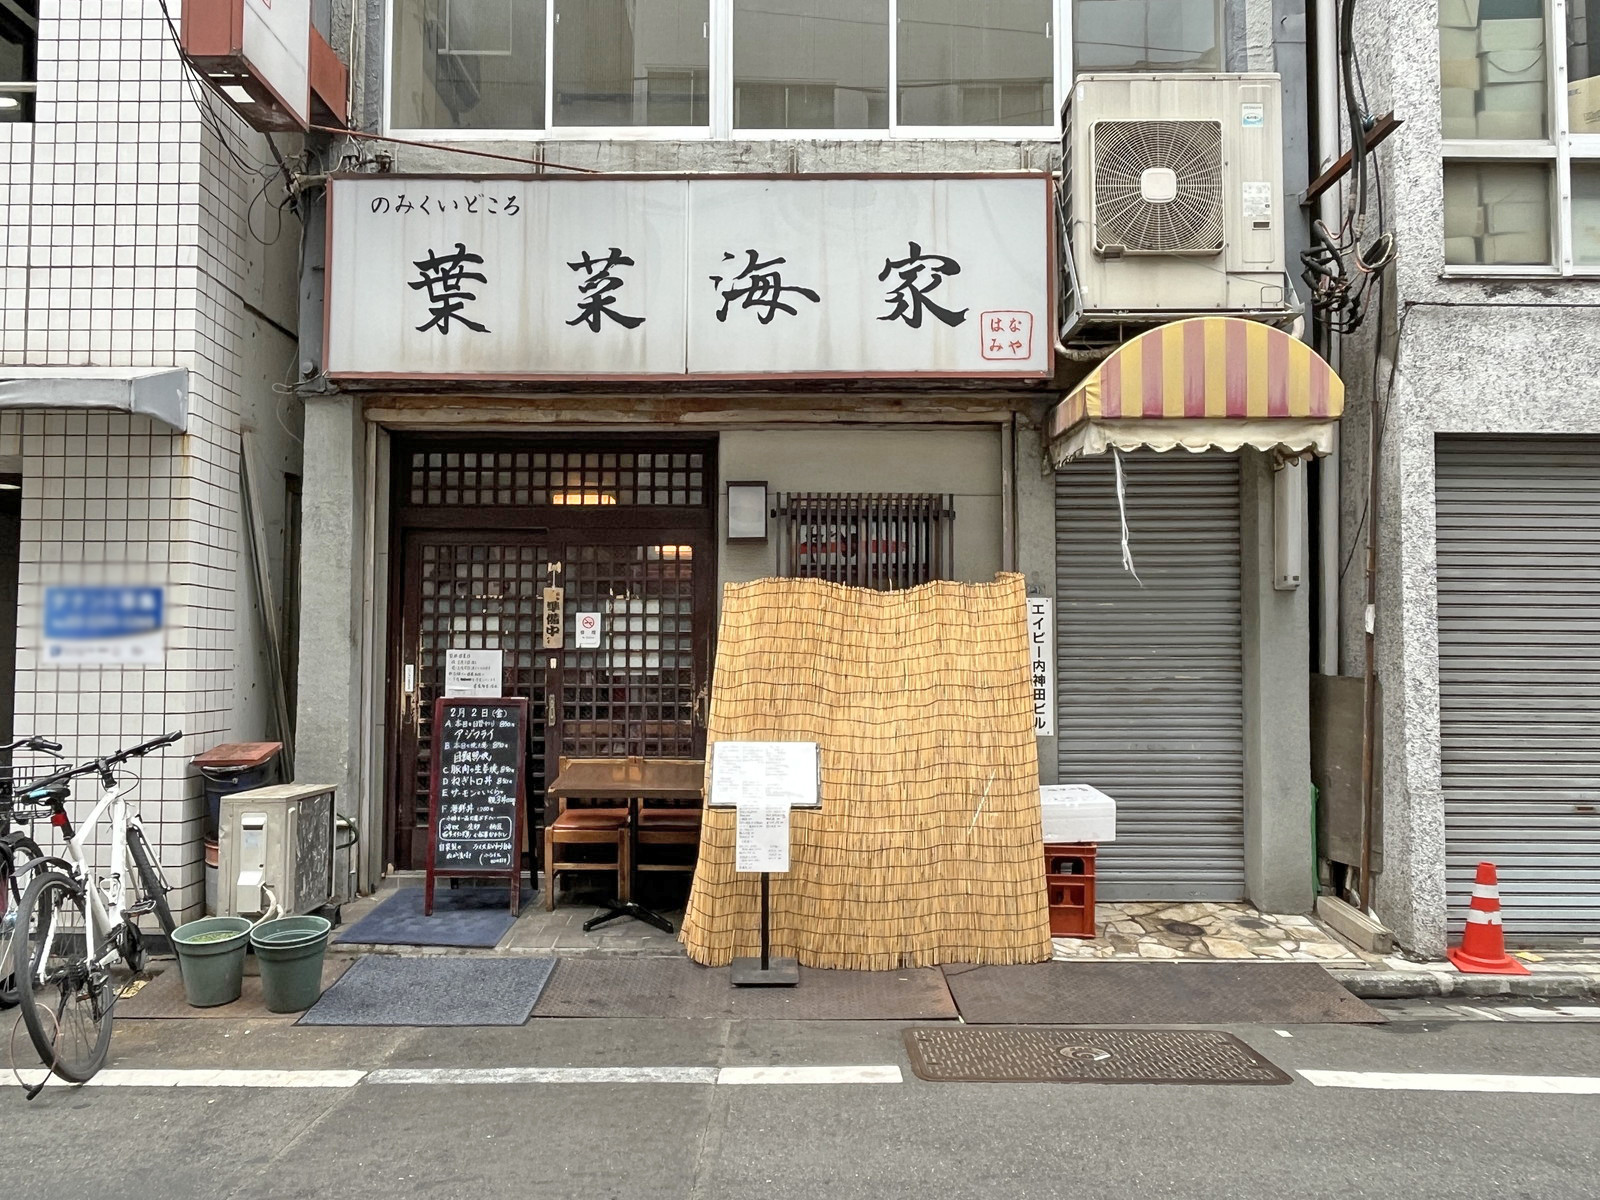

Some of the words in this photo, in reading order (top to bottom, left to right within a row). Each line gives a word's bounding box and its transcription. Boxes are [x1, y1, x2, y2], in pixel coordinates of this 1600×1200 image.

[371, 194, 520, 216] のみくいどころ
[407, 242, 968, 335] 葉菜海家
[990, 317, 1022, 332] はな
[989, 338, 1023, 355] みや
[546, 601, 560, 637] 準備中
[453, 728, 495, 741] アジフライ
[451, 775, 493, 786] ねぎトロ丼
